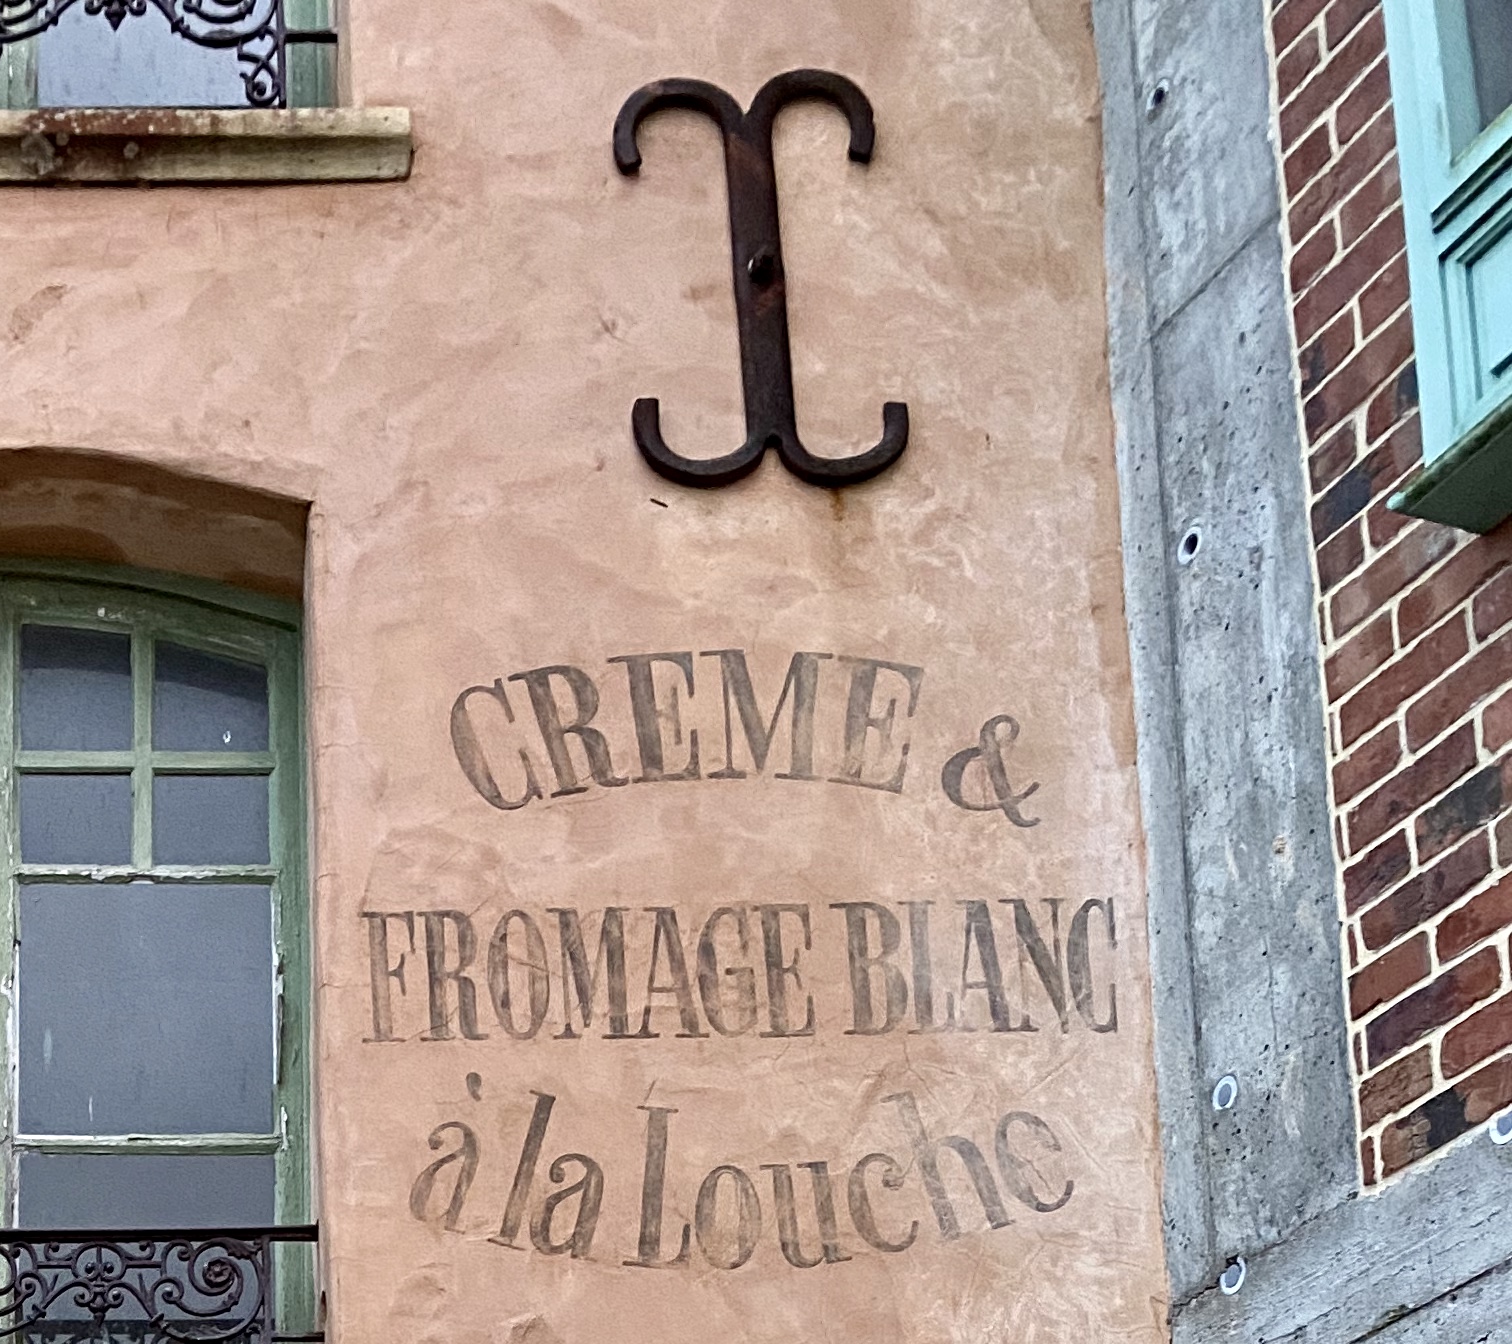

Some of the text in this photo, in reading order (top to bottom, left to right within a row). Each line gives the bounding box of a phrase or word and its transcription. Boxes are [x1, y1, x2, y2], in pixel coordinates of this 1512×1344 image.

[449, 649, 1042, 828] CREME &
[358, 896, 1119, 1044] FROMAGE BLANC
[487, 1089, 605, 1261] la
[624, 1089, 1075, 1272] Louche
